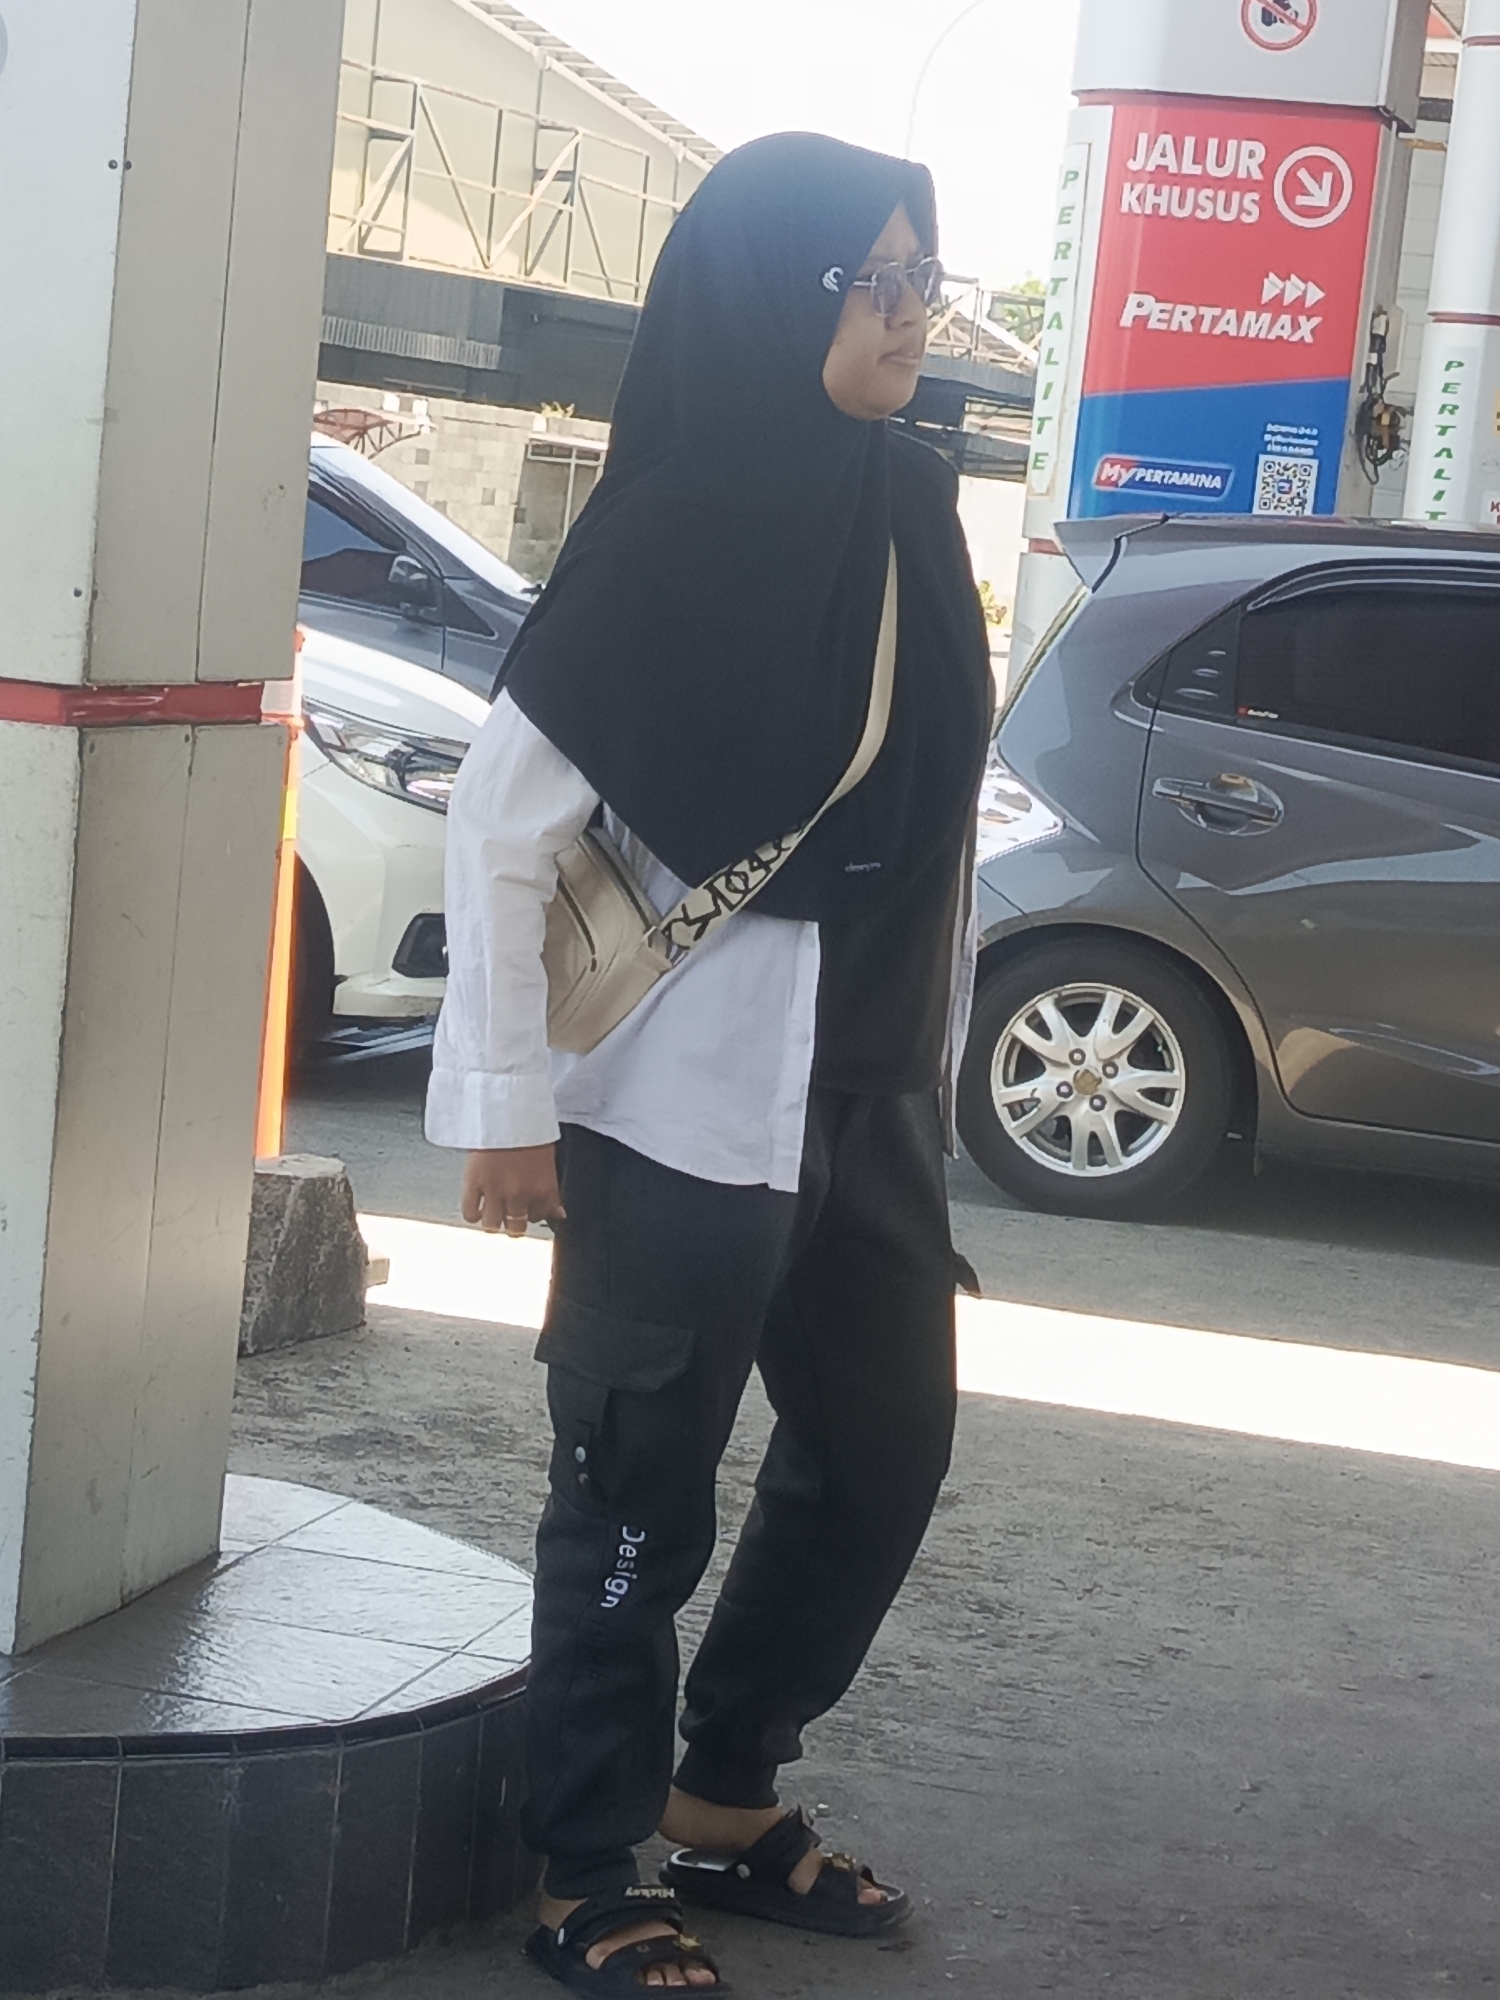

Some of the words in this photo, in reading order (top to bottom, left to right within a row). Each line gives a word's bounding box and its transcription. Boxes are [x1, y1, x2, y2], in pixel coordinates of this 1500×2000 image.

[1127, 132, 1266, 180] JALUR
[1120, 182, 1260, 224] KHUSUS
[1032, 170, 1079, 470] PERTALITE
[1119, 292, 1323, 343] PERTAMAX
